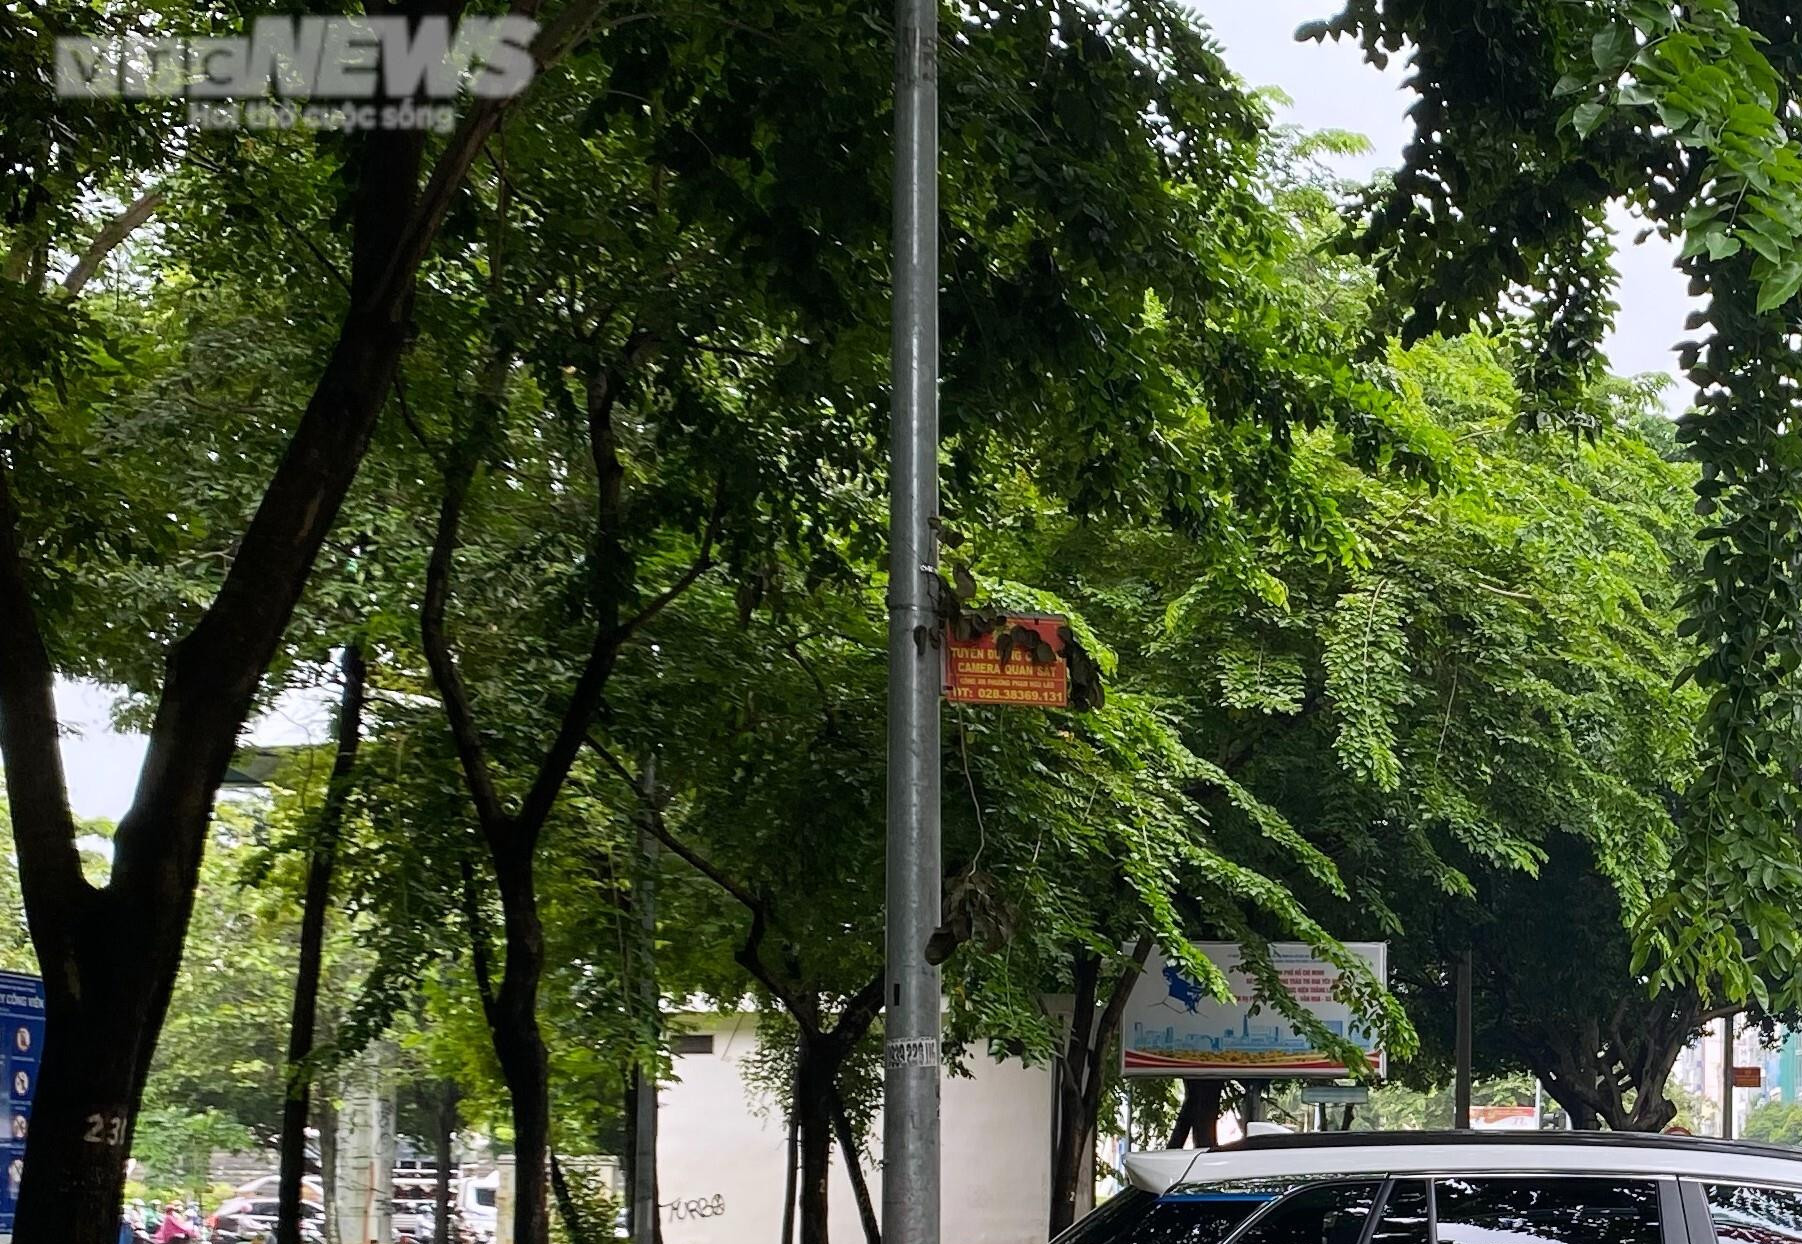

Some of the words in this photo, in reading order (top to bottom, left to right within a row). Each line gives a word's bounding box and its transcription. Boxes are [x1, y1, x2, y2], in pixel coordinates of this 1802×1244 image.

[958, 662, 1000, 674] CAMERA
[1005, 664, 1033, 676] QUAN
[83, 1113, 127, 1146] 231
